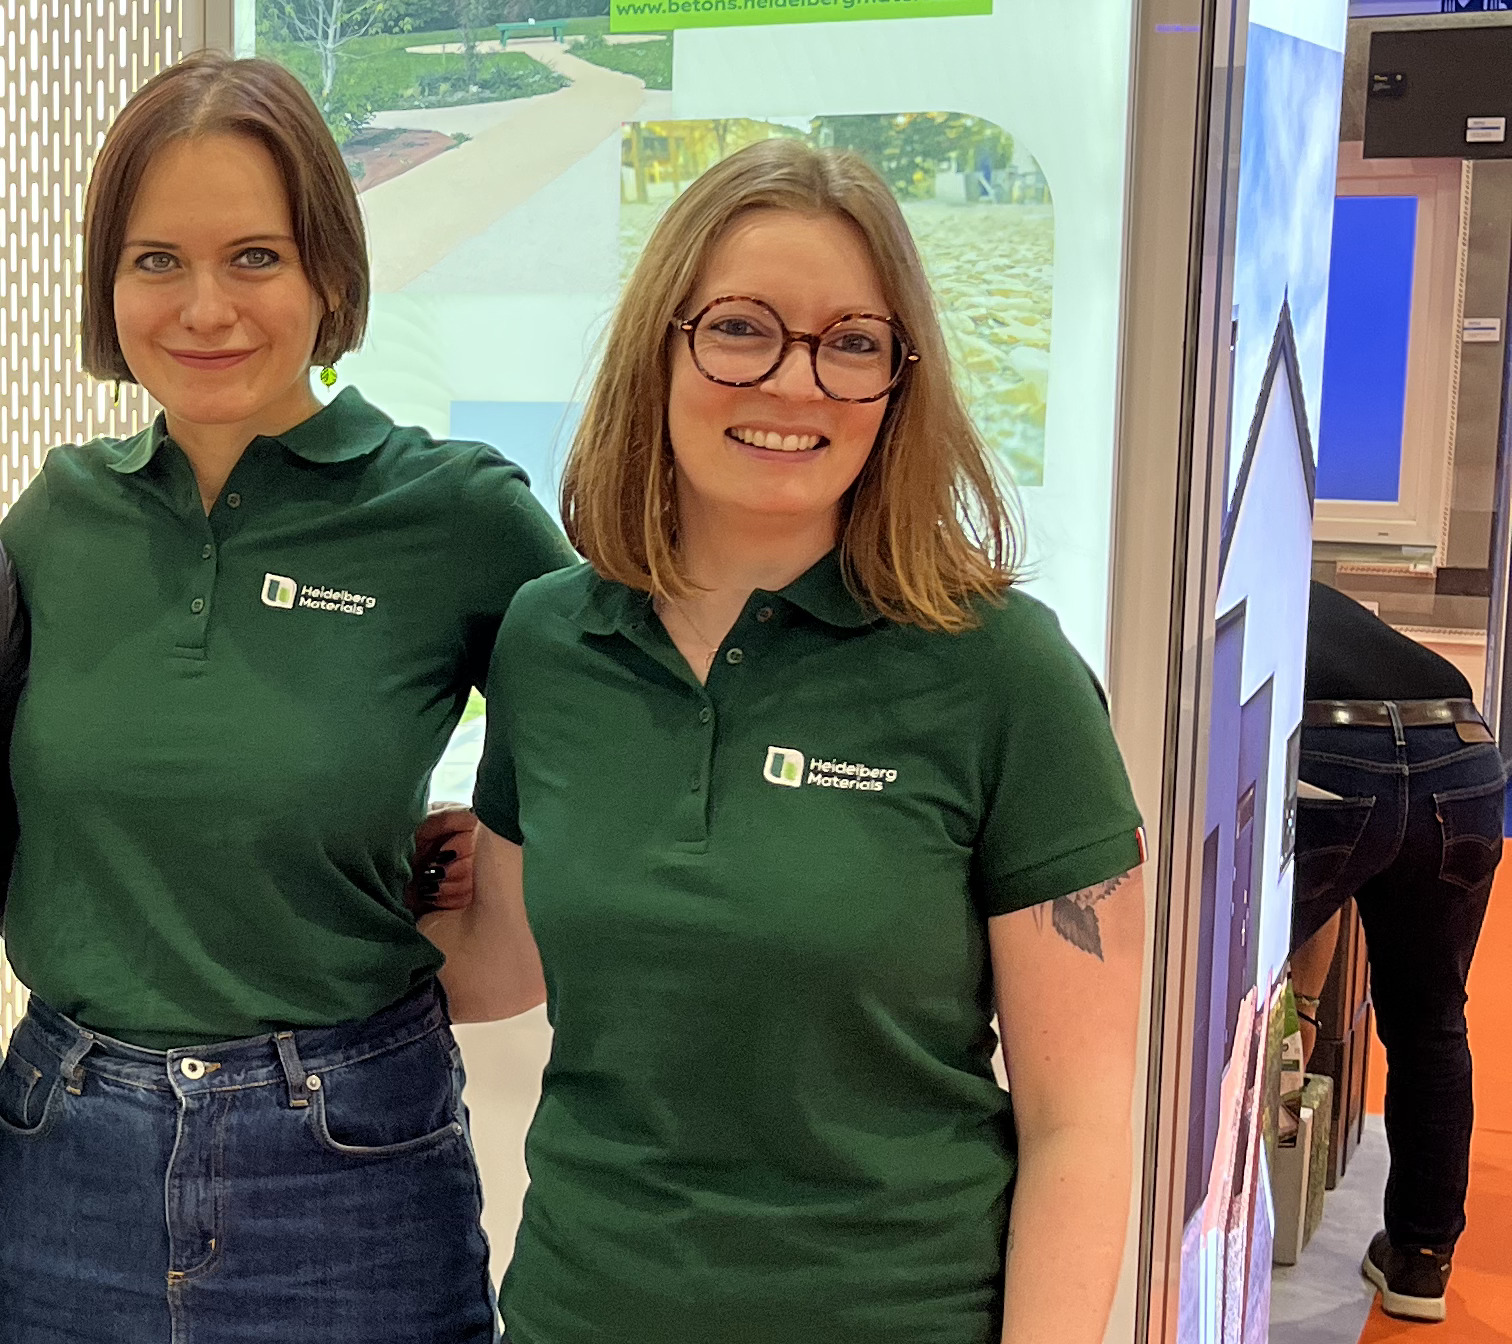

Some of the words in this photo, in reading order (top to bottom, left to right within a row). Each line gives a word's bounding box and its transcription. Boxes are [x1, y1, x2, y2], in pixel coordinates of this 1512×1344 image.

[298, 596, 364, 616] Materials
[300, 584, 377, 608] Heidelberg
[806, 771, 884, 792] Materials
[809, 758, 898, 783] Heidelberg
